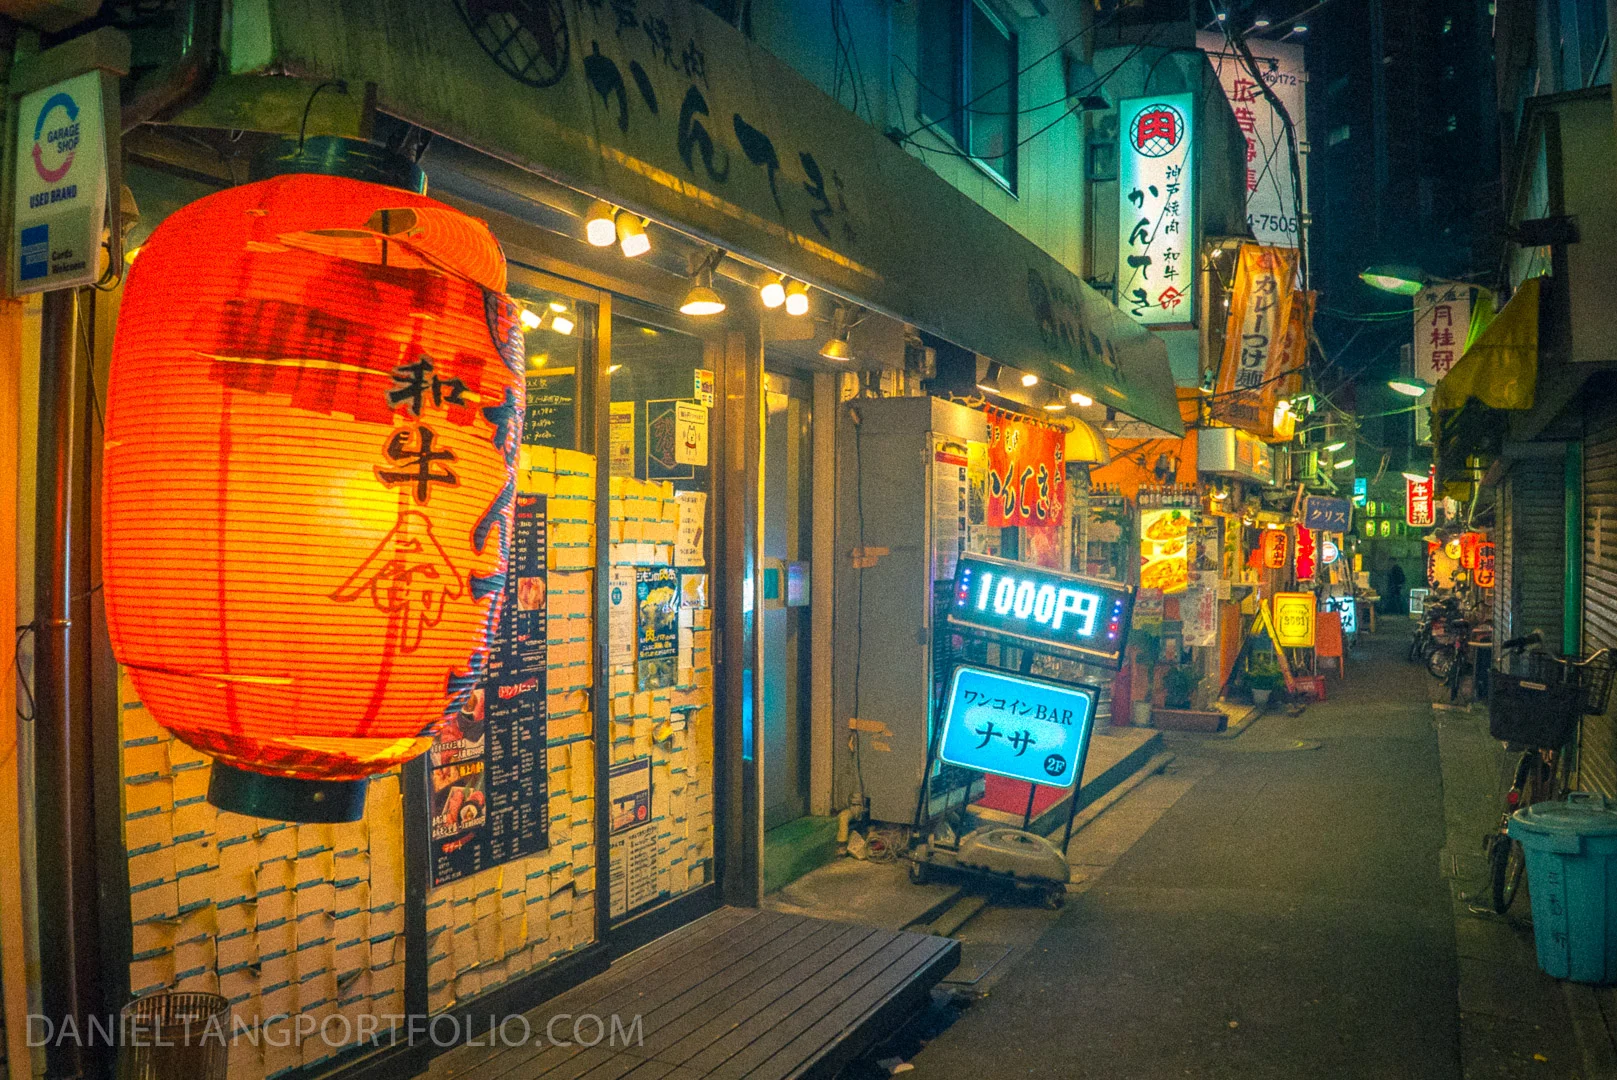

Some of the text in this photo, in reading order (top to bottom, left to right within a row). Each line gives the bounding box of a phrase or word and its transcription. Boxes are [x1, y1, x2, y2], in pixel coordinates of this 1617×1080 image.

[47, 122, 80, 144] GARAGE
[57, 136, 80, 153] SHOP
[1137, 109, 1176, 149] 肉
[29, 184, 78, 209] USED BRAND
[1163, 164, 1182, 235] 神戸焼肉
[1126, 184, 1159, 317] かんてき
[1235, 275, 1277, 390] カレーつけ麺
[1430, 305, 1456, 372] 月桂冠
[986, 460, 1051, 519] んてき
[1311, 509, 1346, 524] クリス
[978, 572, 1102, 637] 1000円
[975, 721, 1037, 757] ナサ
[1047, 757, 1066, 773] 2F
